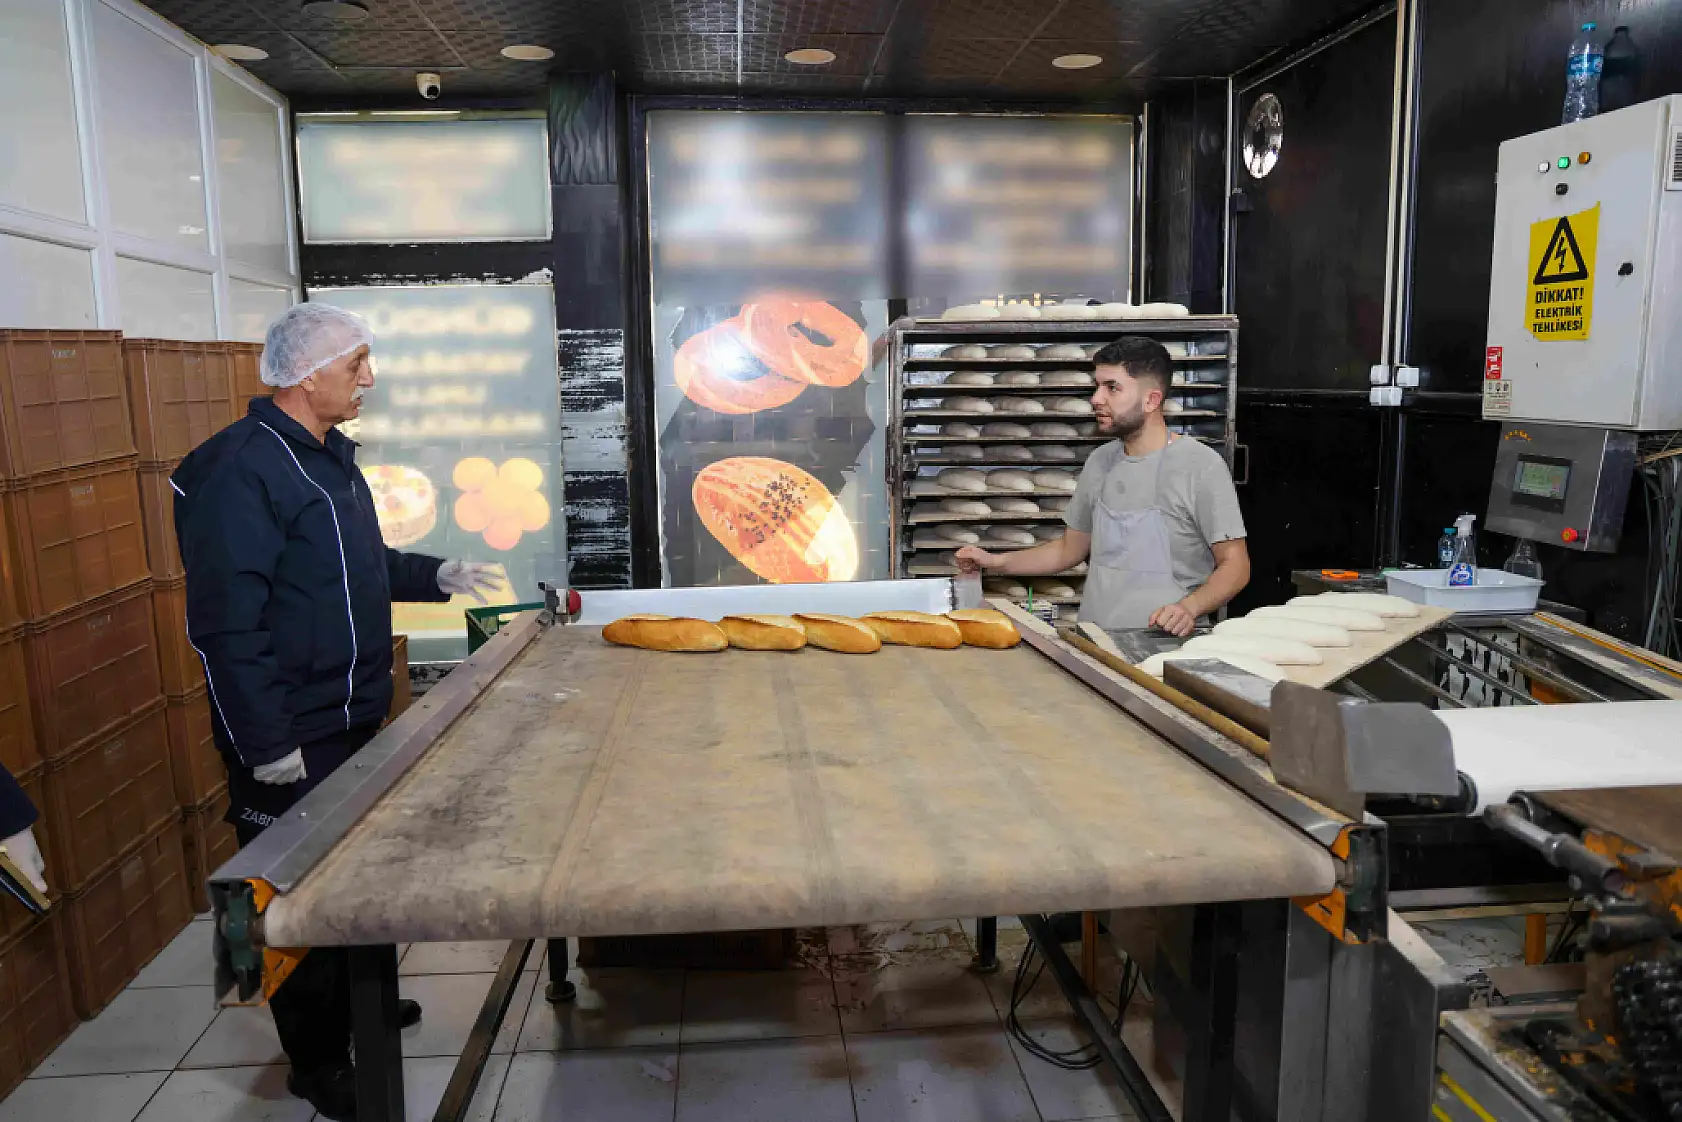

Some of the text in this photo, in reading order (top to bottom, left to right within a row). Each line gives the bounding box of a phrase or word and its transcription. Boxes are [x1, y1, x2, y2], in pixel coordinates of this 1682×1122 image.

[1535, 286, 1584, 303] DİKKAT!
[1535, 304, 1582, 319] ELEKTRİK
[1533, 317, 1582, 332] TEHLİKESİ
